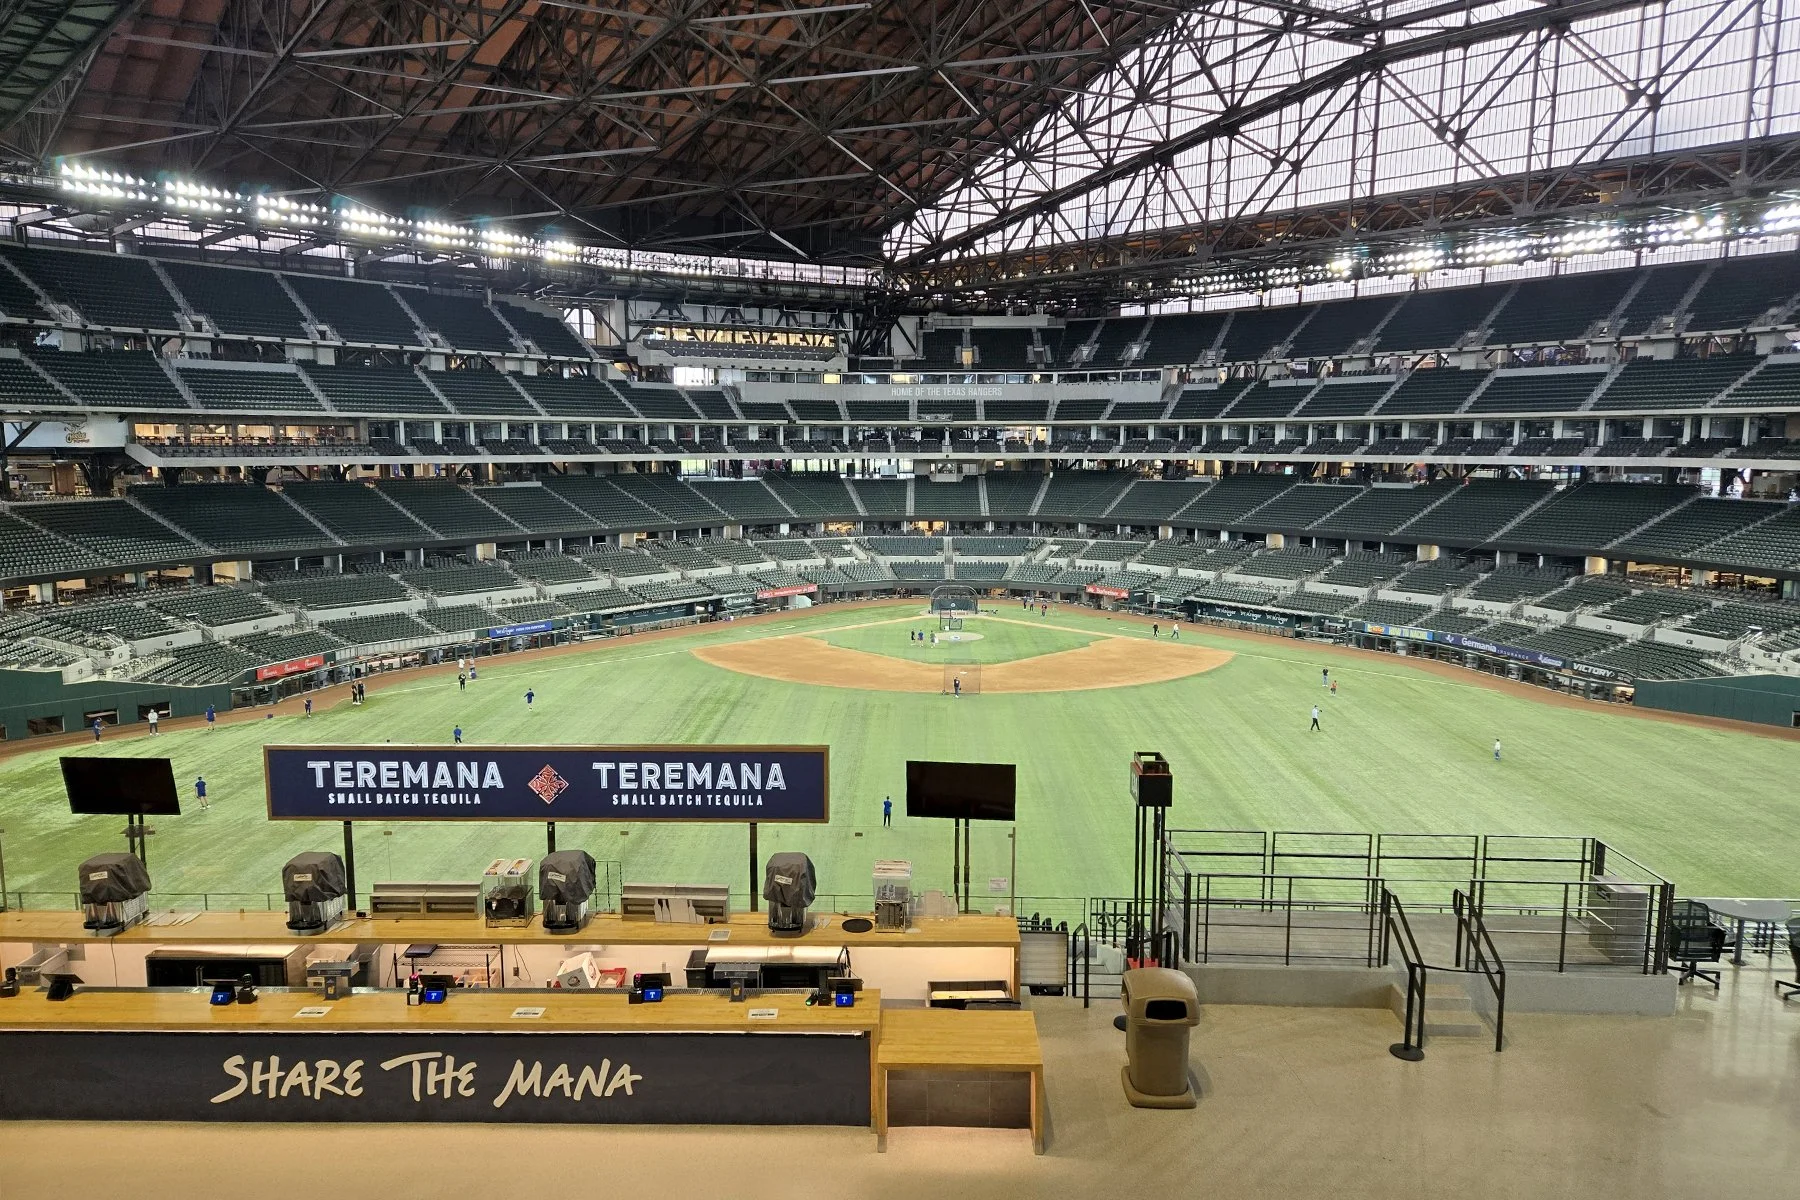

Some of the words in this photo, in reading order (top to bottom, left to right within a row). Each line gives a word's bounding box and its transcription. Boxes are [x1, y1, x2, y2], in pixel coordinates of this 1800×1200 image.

[891, 387, 913, 397] HOME
[915, 387, 925, 397] OF
[927, 387, 941, 397] THE
[943, 387, 966, 397] TEXAS
[968, 387, 1003, 397] RANGERS
[1272, 613, 1289, 624] Kroger
[1461, 637, 1497, 653] Germania
[1497, 649, 1529, 660] INSURANCE
[307, 760, 504, 789] TEREMANA
[592, 762, 786, 790] TEREMANA
[328, 793, 372, 804] SMALL
[376, 793, 419, 804] BATCH
[424, 793, 481, 805] TEQUILA
[612, 794, 655, 805] SMALL
[660, 794, 702, 806] BATCH
[707, 794, 763, 806] TEQUILA
[430, 992, 437, 1000] T
[210, 1054, 365, 1104] SHARE
[380, 1051, 477, 1102] THE
[493, 1057, 643, 1108] MANA
